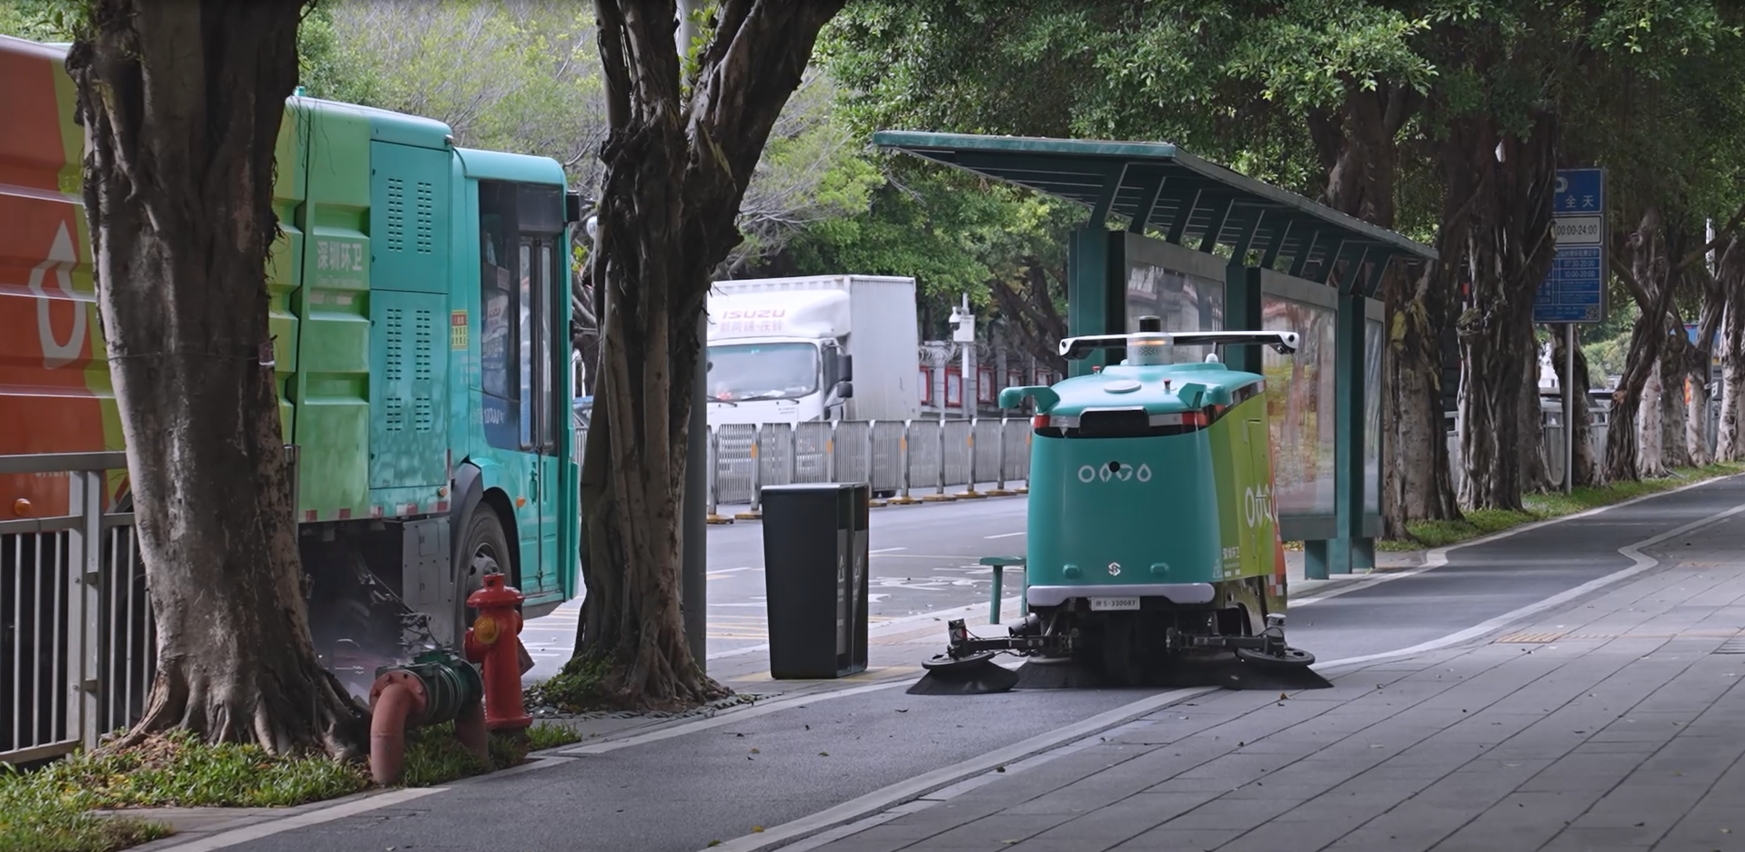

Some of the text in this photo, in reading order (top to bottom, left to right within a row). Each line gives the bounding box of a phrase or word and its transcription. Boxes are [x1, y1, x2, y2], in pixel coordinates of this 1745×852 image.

[1553, 194, 1594, 208] 全天
[1556, 225, 1597, 235] 00:00-24:00
[317, 240, 363, 271] 深圳环卫
[723, 309, 786, 319] ISUZU
